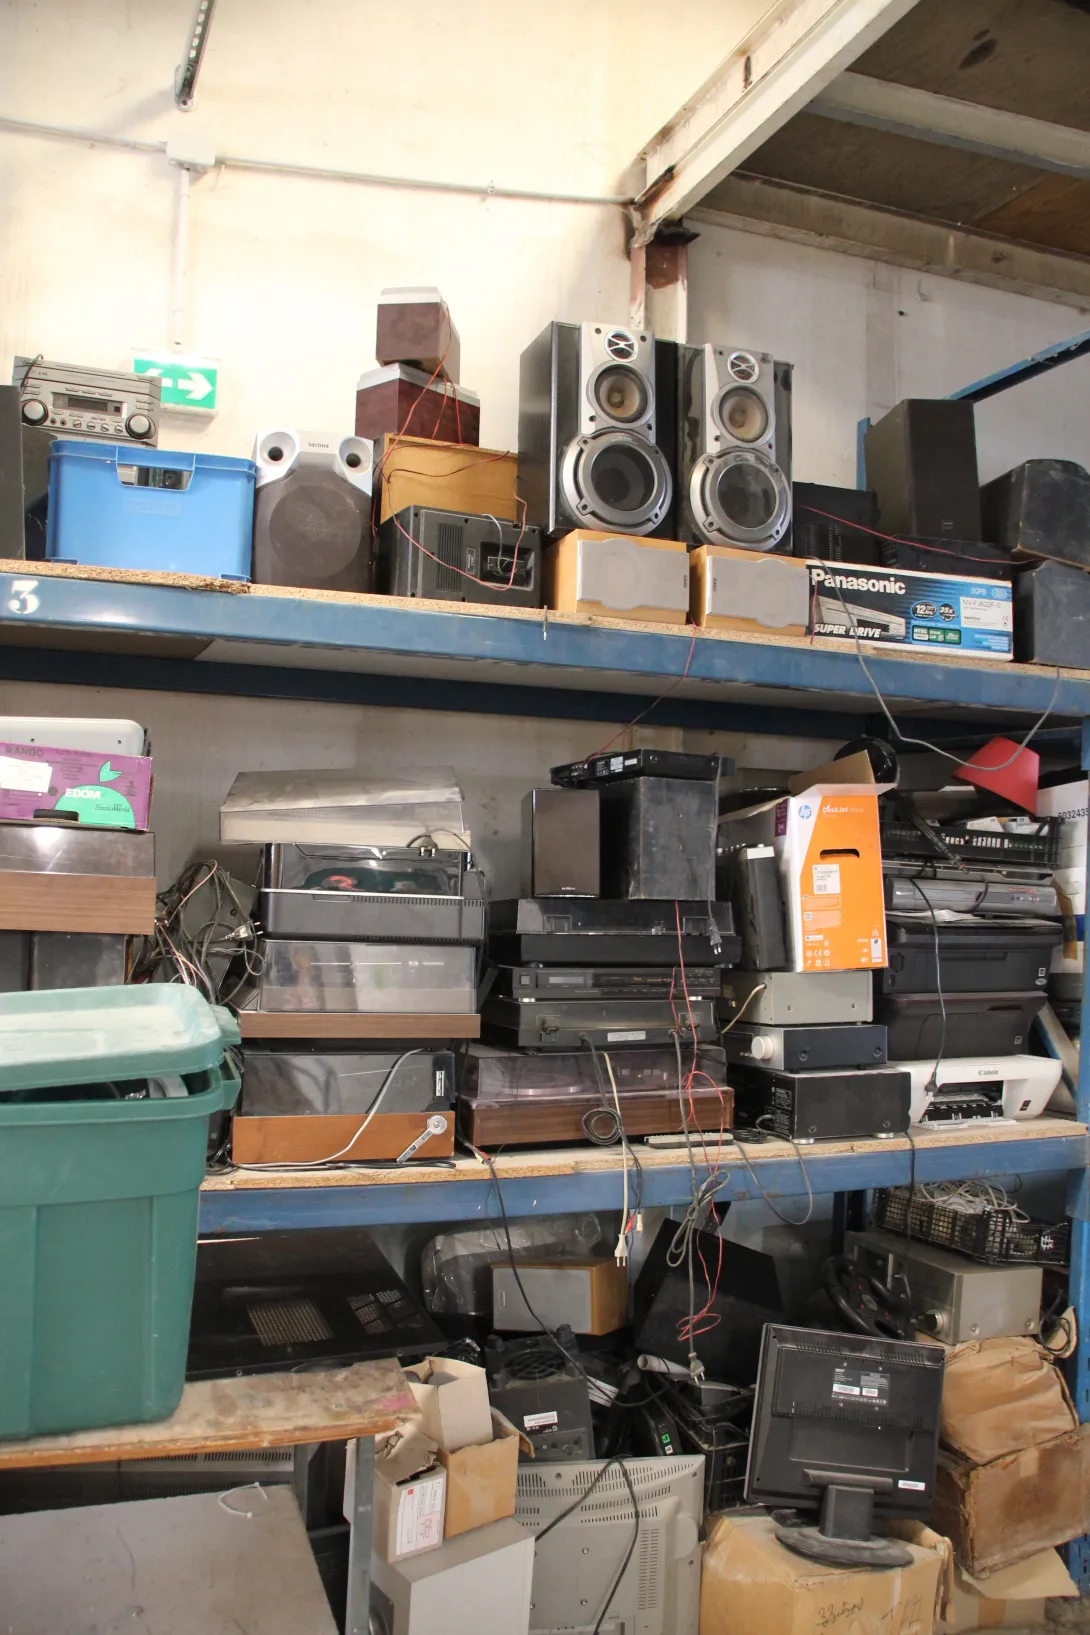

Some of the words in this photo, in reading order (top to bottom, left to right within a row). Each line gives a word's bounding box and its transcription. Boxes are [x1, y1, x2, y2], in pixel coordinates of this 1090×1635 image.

[811, 568, 906, 595] Panasonic
[8, 580, 40, 614] 3
[915, 604, 926, 614] 12
[814, 623, 846, 635] SUPER
[849, 627, 881, 638] DRIVE
